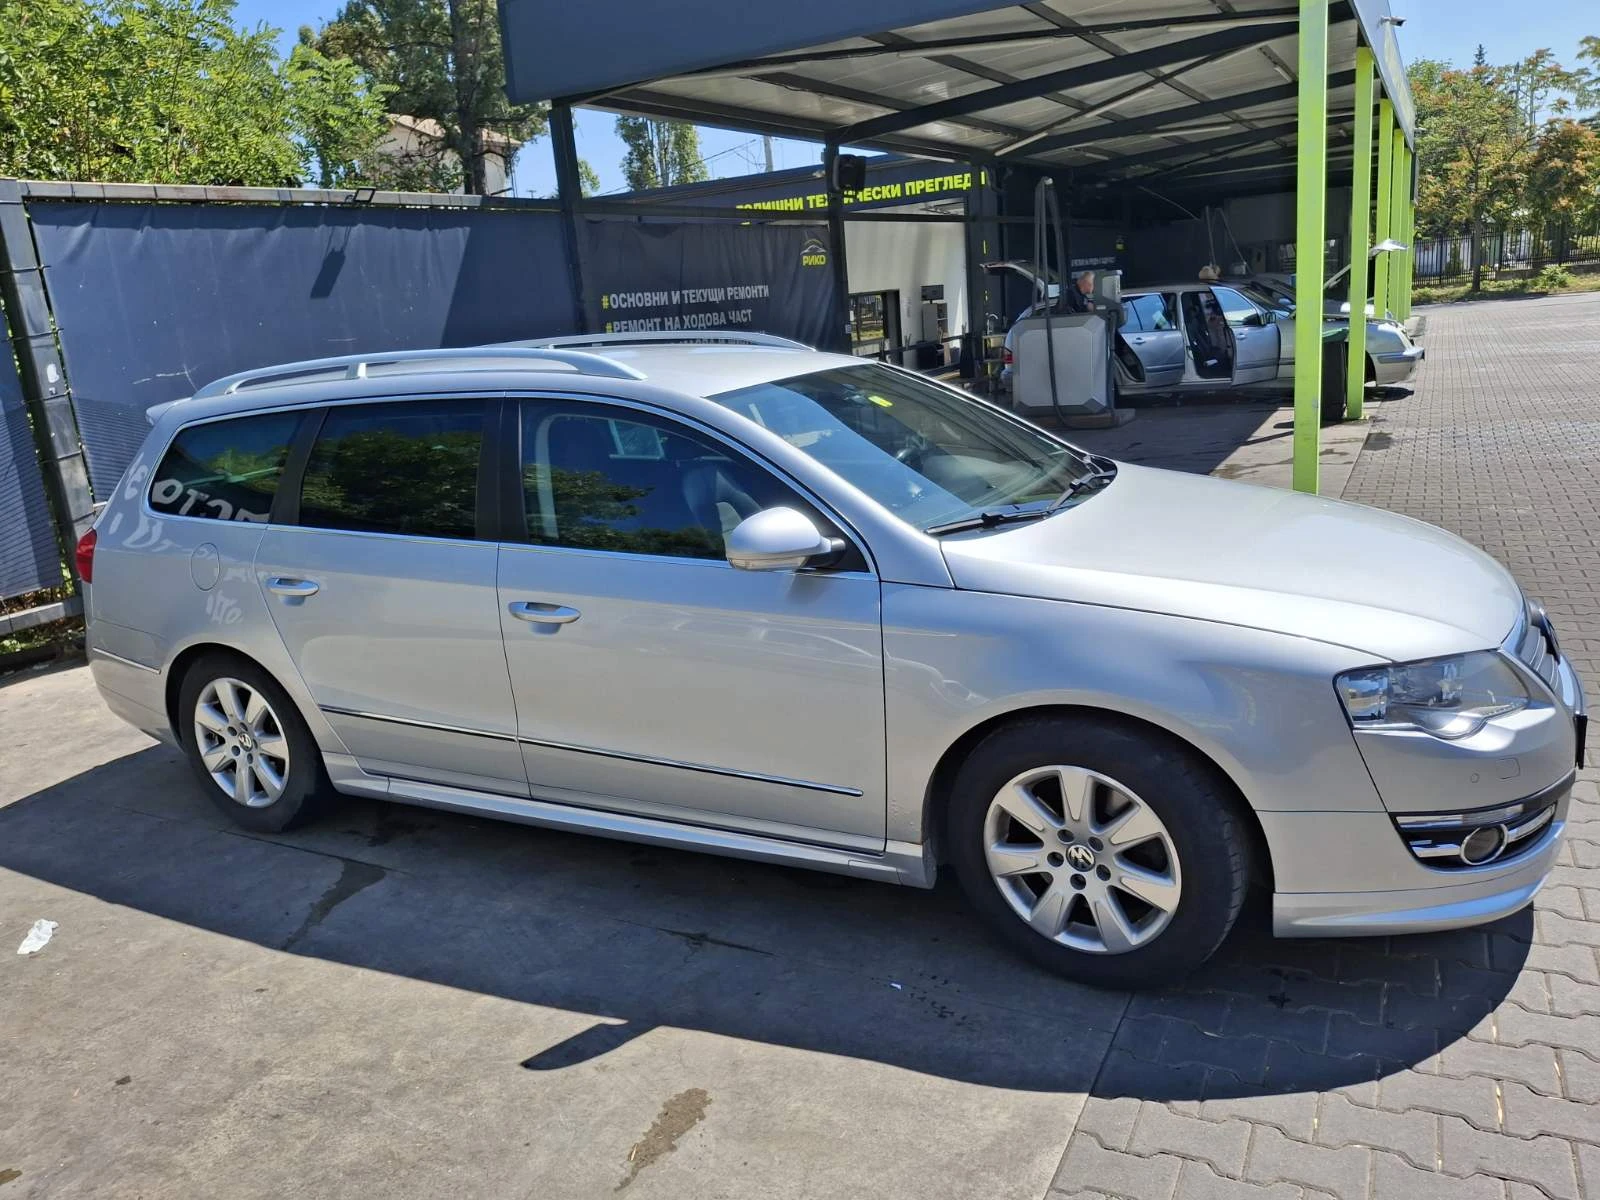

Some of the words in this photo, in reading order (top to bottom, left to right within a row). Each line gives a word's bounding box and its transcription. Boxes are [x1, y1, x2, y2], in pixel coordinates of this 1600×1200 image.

[736, 197, 804, 211] ИШНИ
[806, 183, 901, 209] ТЕИЧЕСКИ
[802, 254, 826, 266] РИКО
[601, 290, 668, 309] #ОСНОВНИ
[671, 290, 681, 305] И
[682, 287, 725, 304] ТЕКУЩИ
[727, 285, 769, 300] РЕМОНТИ
[605, 317, 662, 333] #РЕМОНТ
[664, 315, 681, 331] НА
[682, 311, 727, 329] ХОДОВА
[728, 309, 752, 324] ЧАСТ
